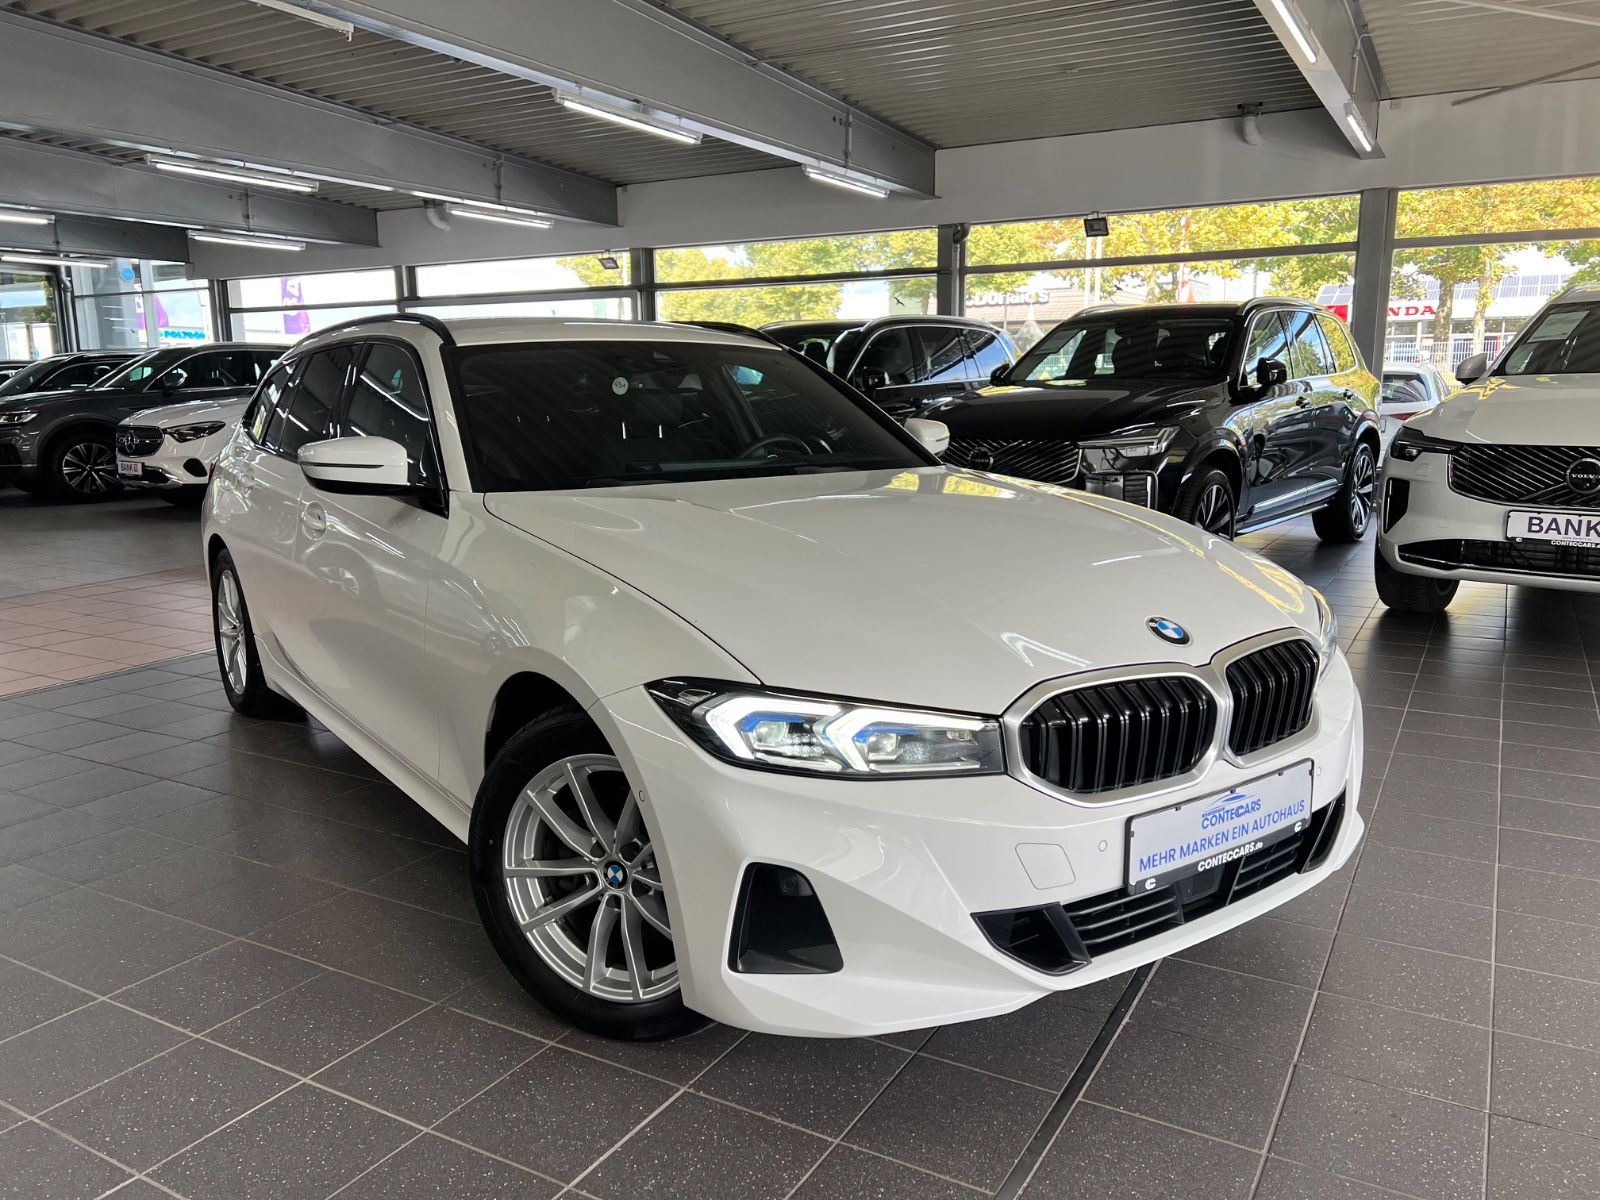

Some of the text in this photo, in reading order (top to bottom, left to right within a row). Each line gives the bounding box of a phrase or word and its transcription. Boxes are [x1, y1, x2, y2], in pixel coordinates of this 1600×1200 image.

[1388, 306, 1436, 316] NDA
[1528, 516, 1600, 537] BANK
[1139, 848, 1176, 872] MEHR
[1179, 829, 1230, 860] MARKEN
[1231, 822, 1249, 841] EIN
[1251, 799, 1305, 833] AUTOHAUS
[1198, 842, 1263, 872] CONTECCARS.de
